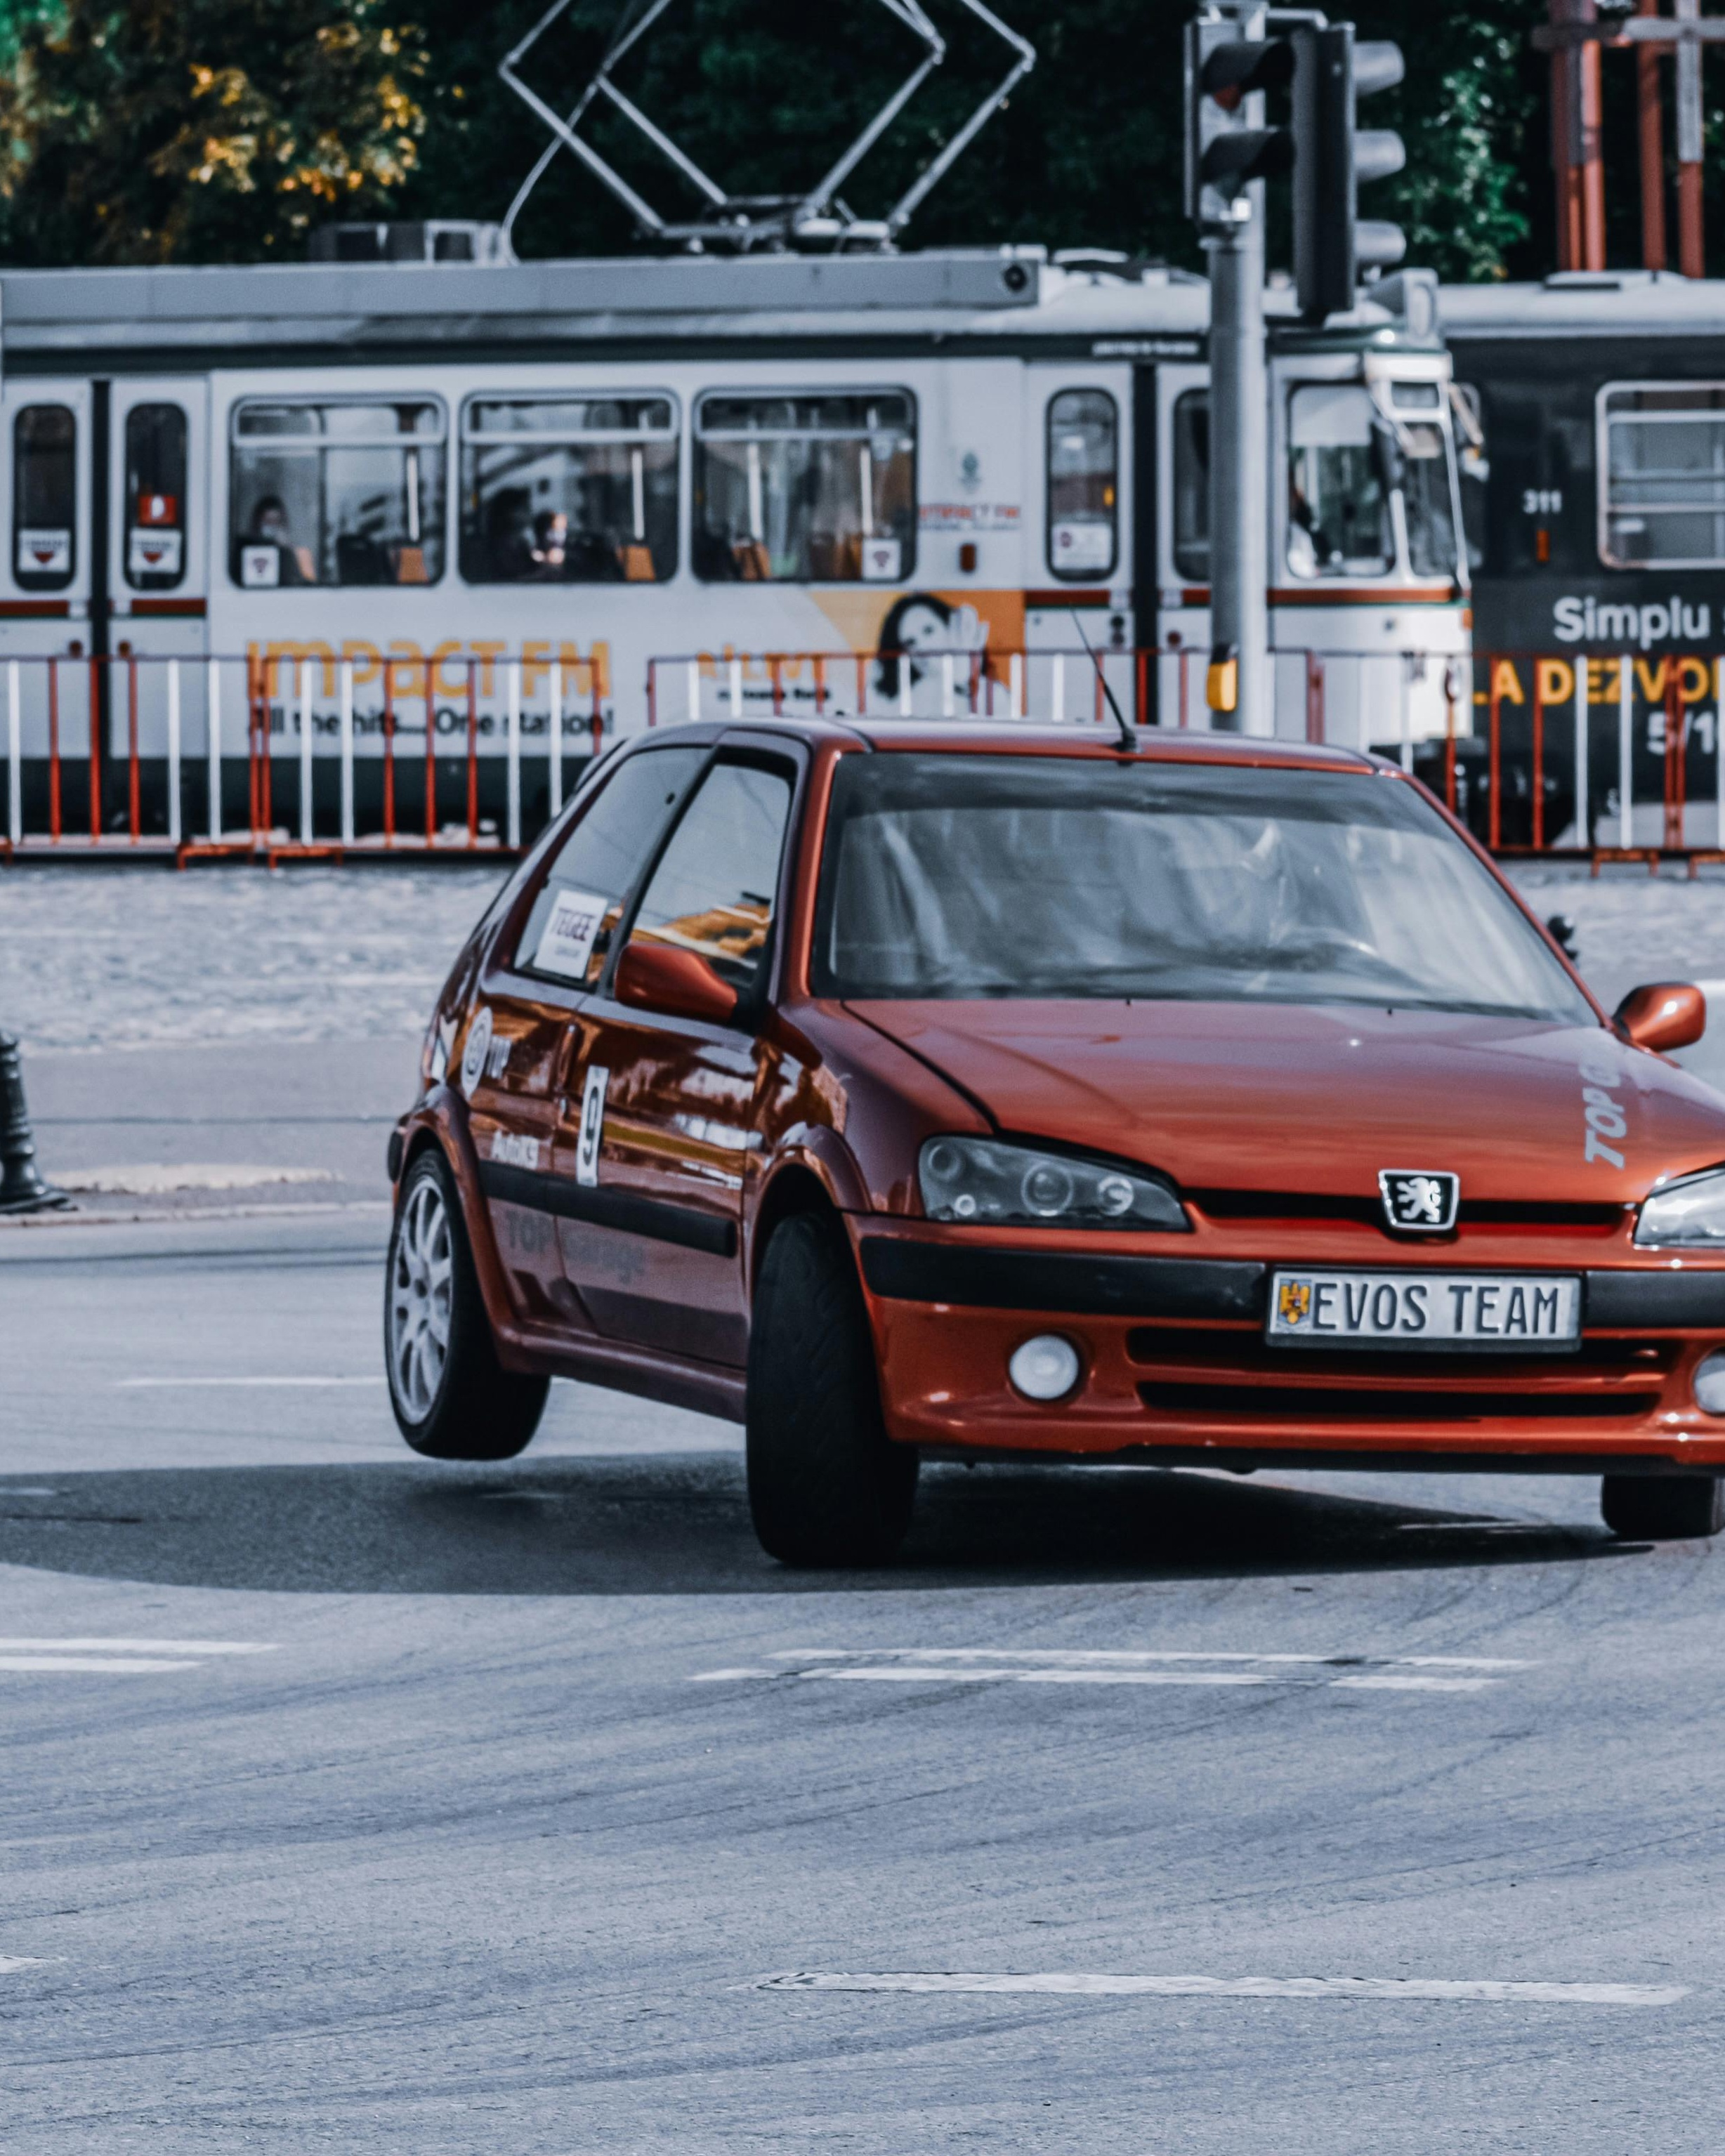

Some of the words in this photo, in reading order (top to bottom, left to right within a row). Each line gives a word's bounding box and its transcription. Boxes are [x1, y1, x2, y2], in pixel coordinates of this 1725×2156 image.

[1553, 596, 1710, 651] Simplu
[521, 641, 610, 697] FM
[434, 707, 494, 735] One
[583, 1086, 599, 1166] 9
[1582, 1087, 1627, 1171] TOP
[1313, 1282, 1427, 1332] EVOS
[1448, 1285, 1559, 1334] TEAM
